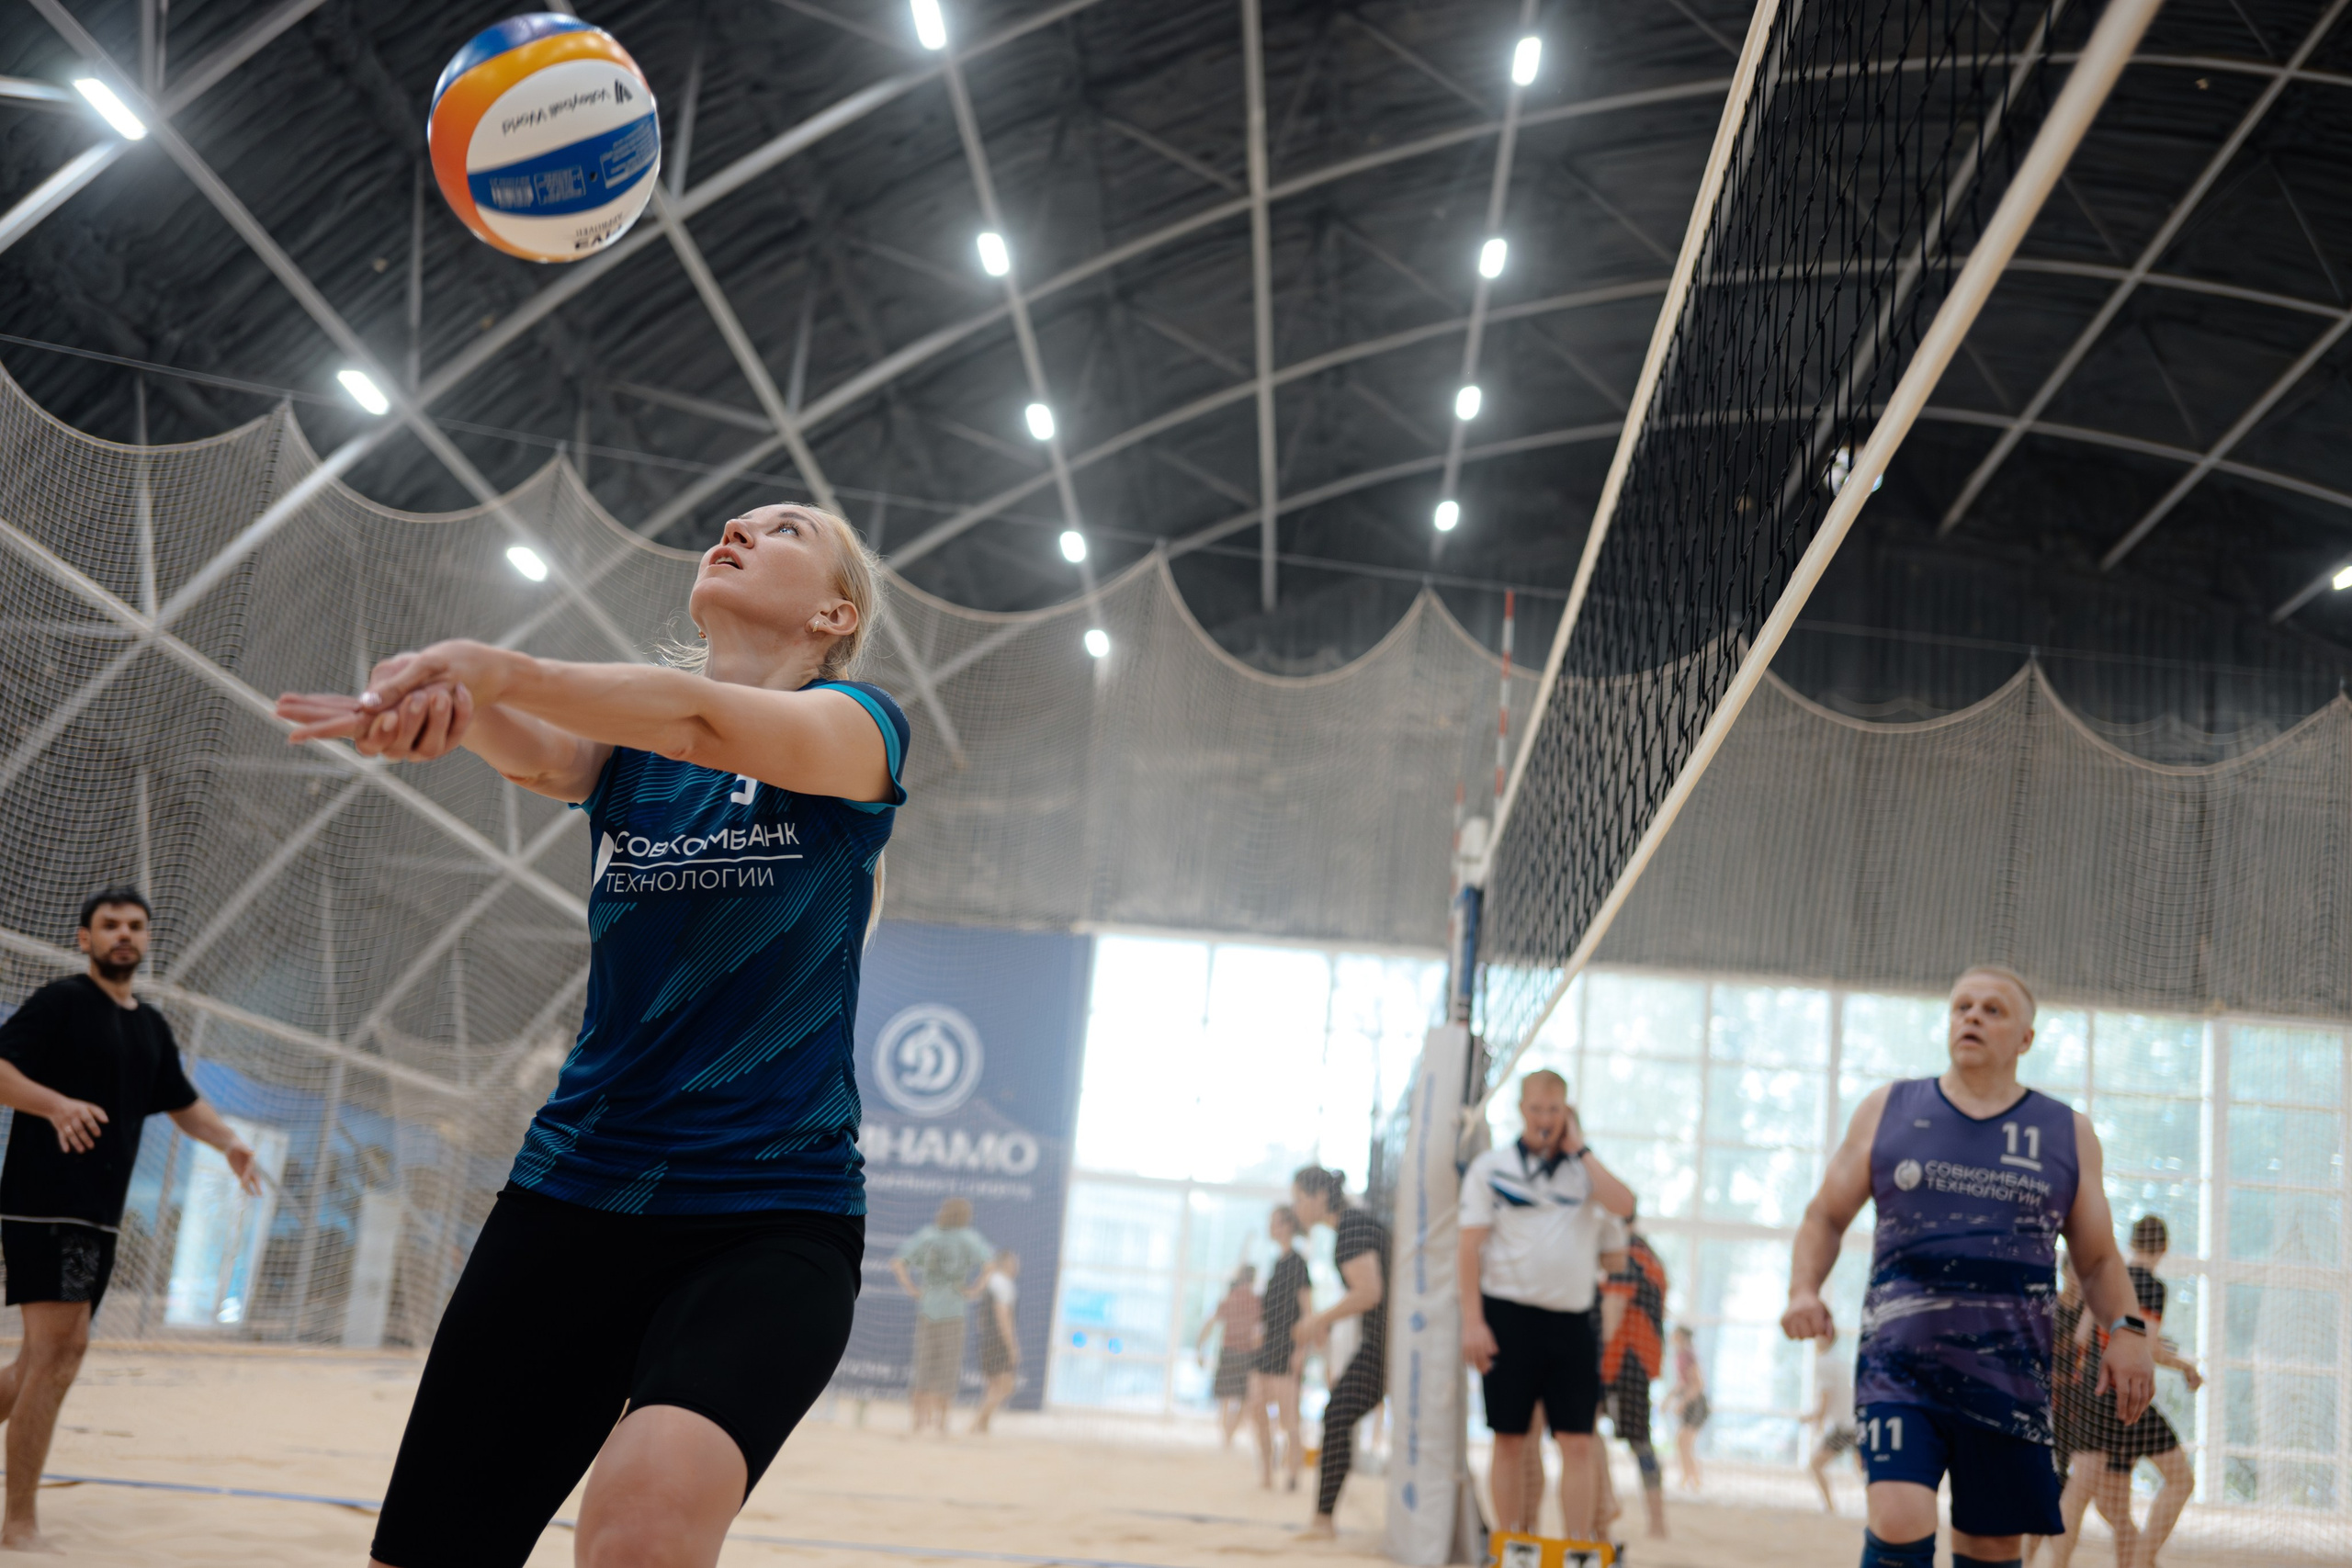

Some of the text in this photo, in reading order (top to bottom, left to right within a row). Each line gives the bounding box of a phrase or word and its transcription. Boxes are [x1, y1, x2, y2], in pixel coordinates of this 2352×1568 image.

[502, 107, 548, 137] World
[614, 822, 800, 859] СОВКОМБАНК
[605, 867, 775, 893] ТЕХНОЛОГИИ
[860, 1125, 1039, 1175] ИНАМО
[2002, 1121, 2041, 1160] 11
[1925, 1160, 2052, 1197] СОВКОМБАНК
[1927, 1178, 2042, 1208] ТЕХНОЛОГИИ
[1868, 1416, 1903, 1452] 11
